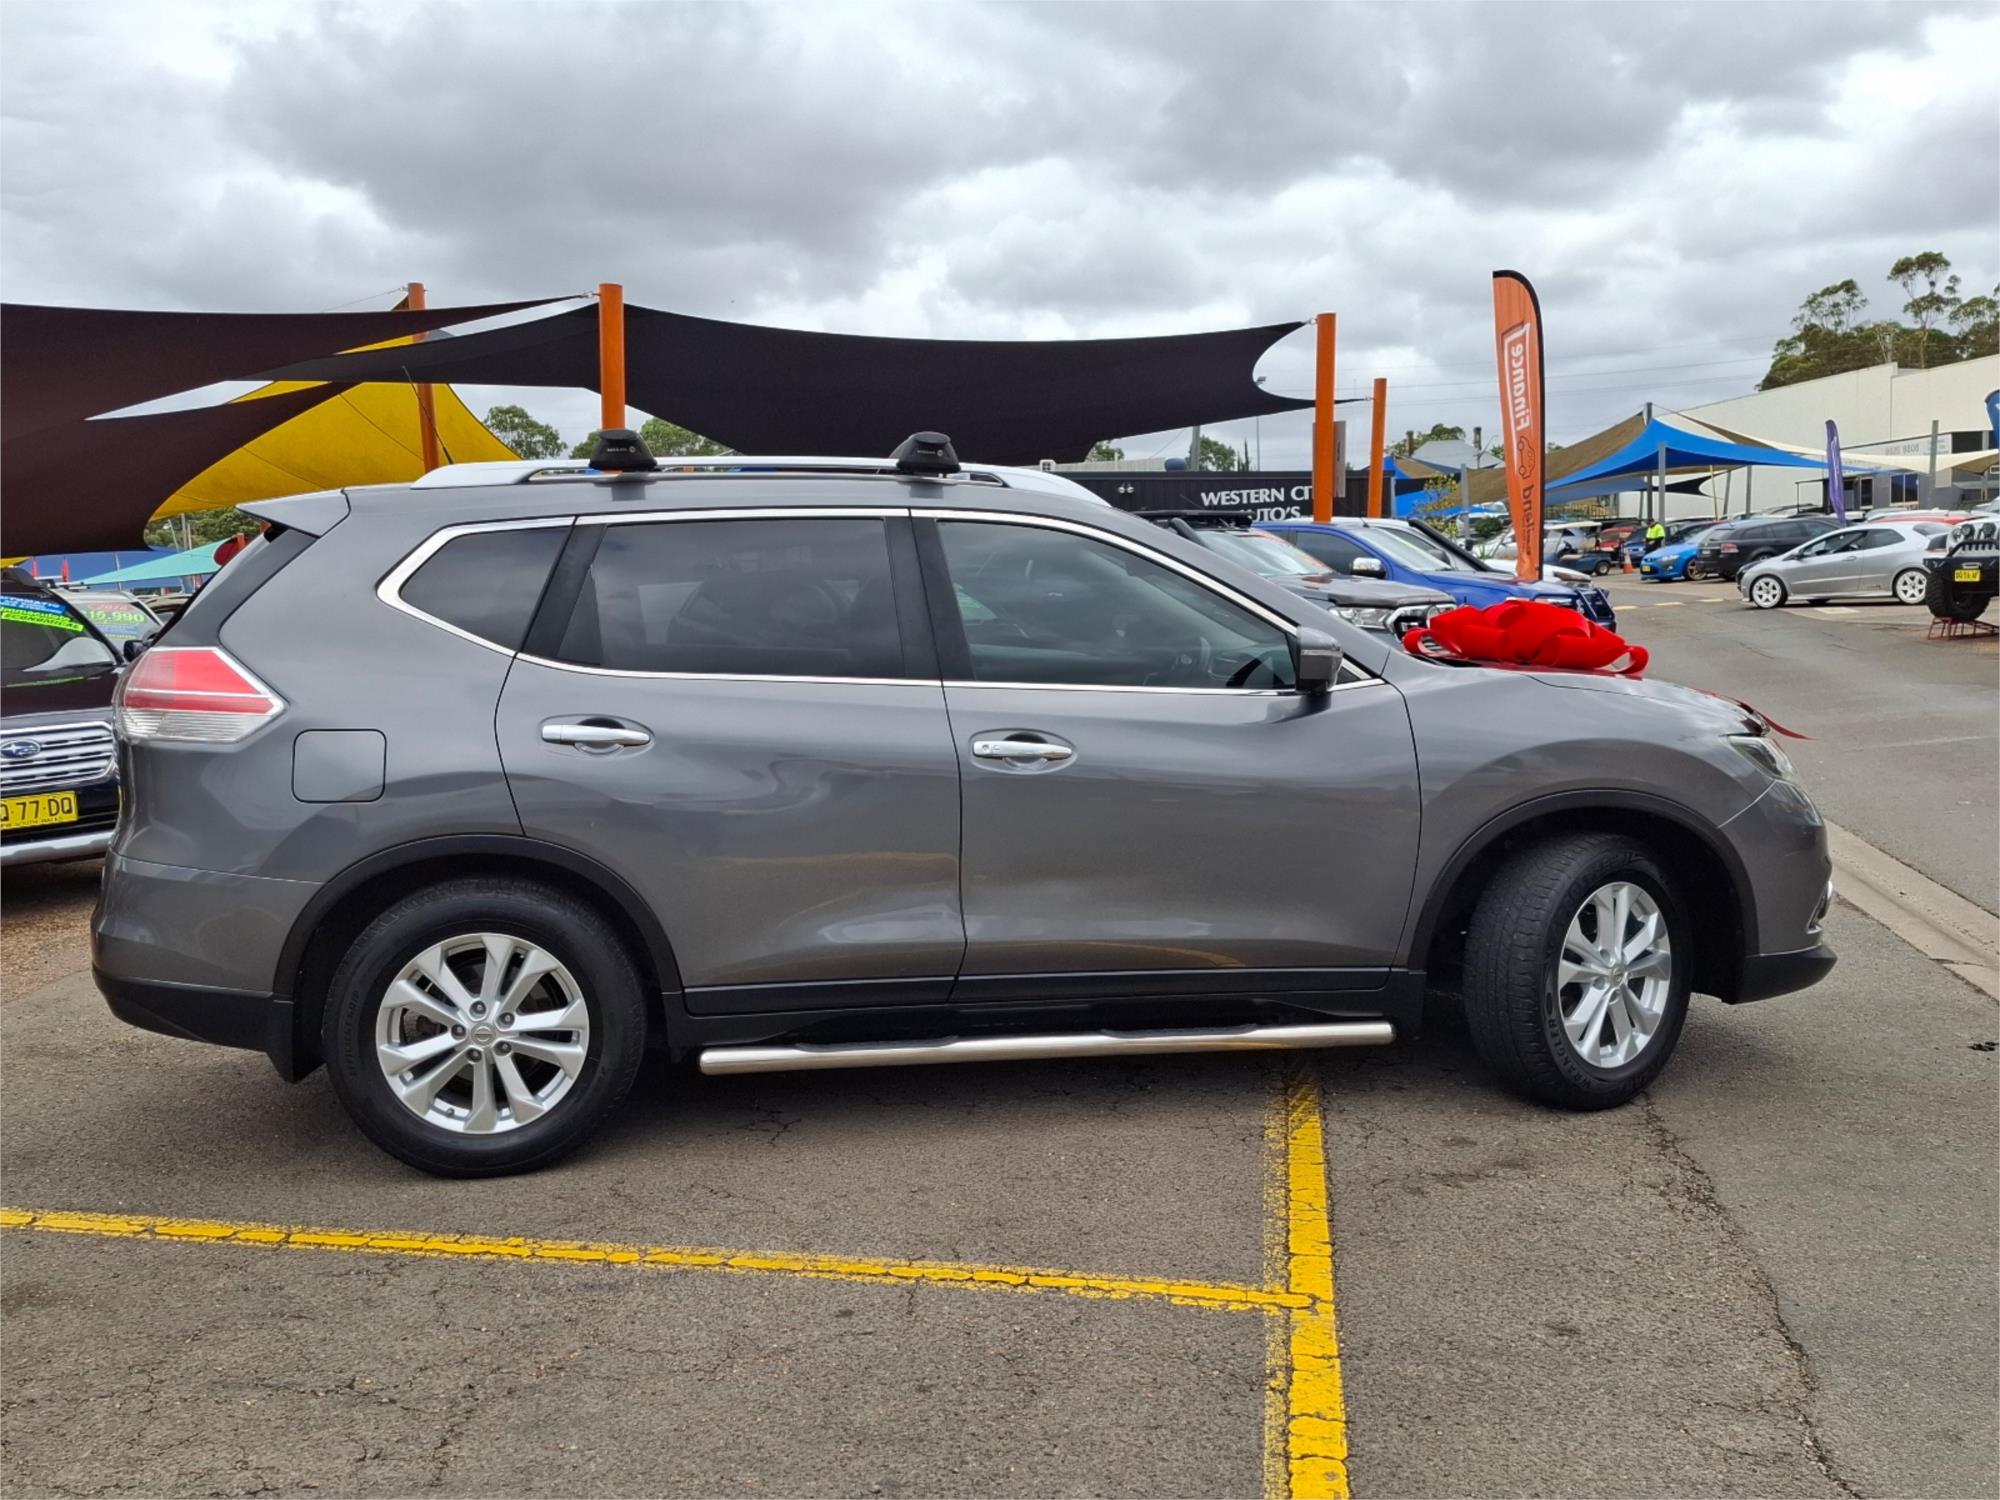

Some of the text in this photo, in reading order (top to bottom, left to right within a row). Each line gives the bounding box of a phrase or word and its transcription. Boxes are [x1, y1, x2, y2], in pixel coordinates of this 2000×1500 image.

[1201, 487, 1285, 506] WESTERN
[1240, 506, 1301, 521] UTO'S
[16, 800, 39, 820] 77
[48, 797, 73, 816] DQ
